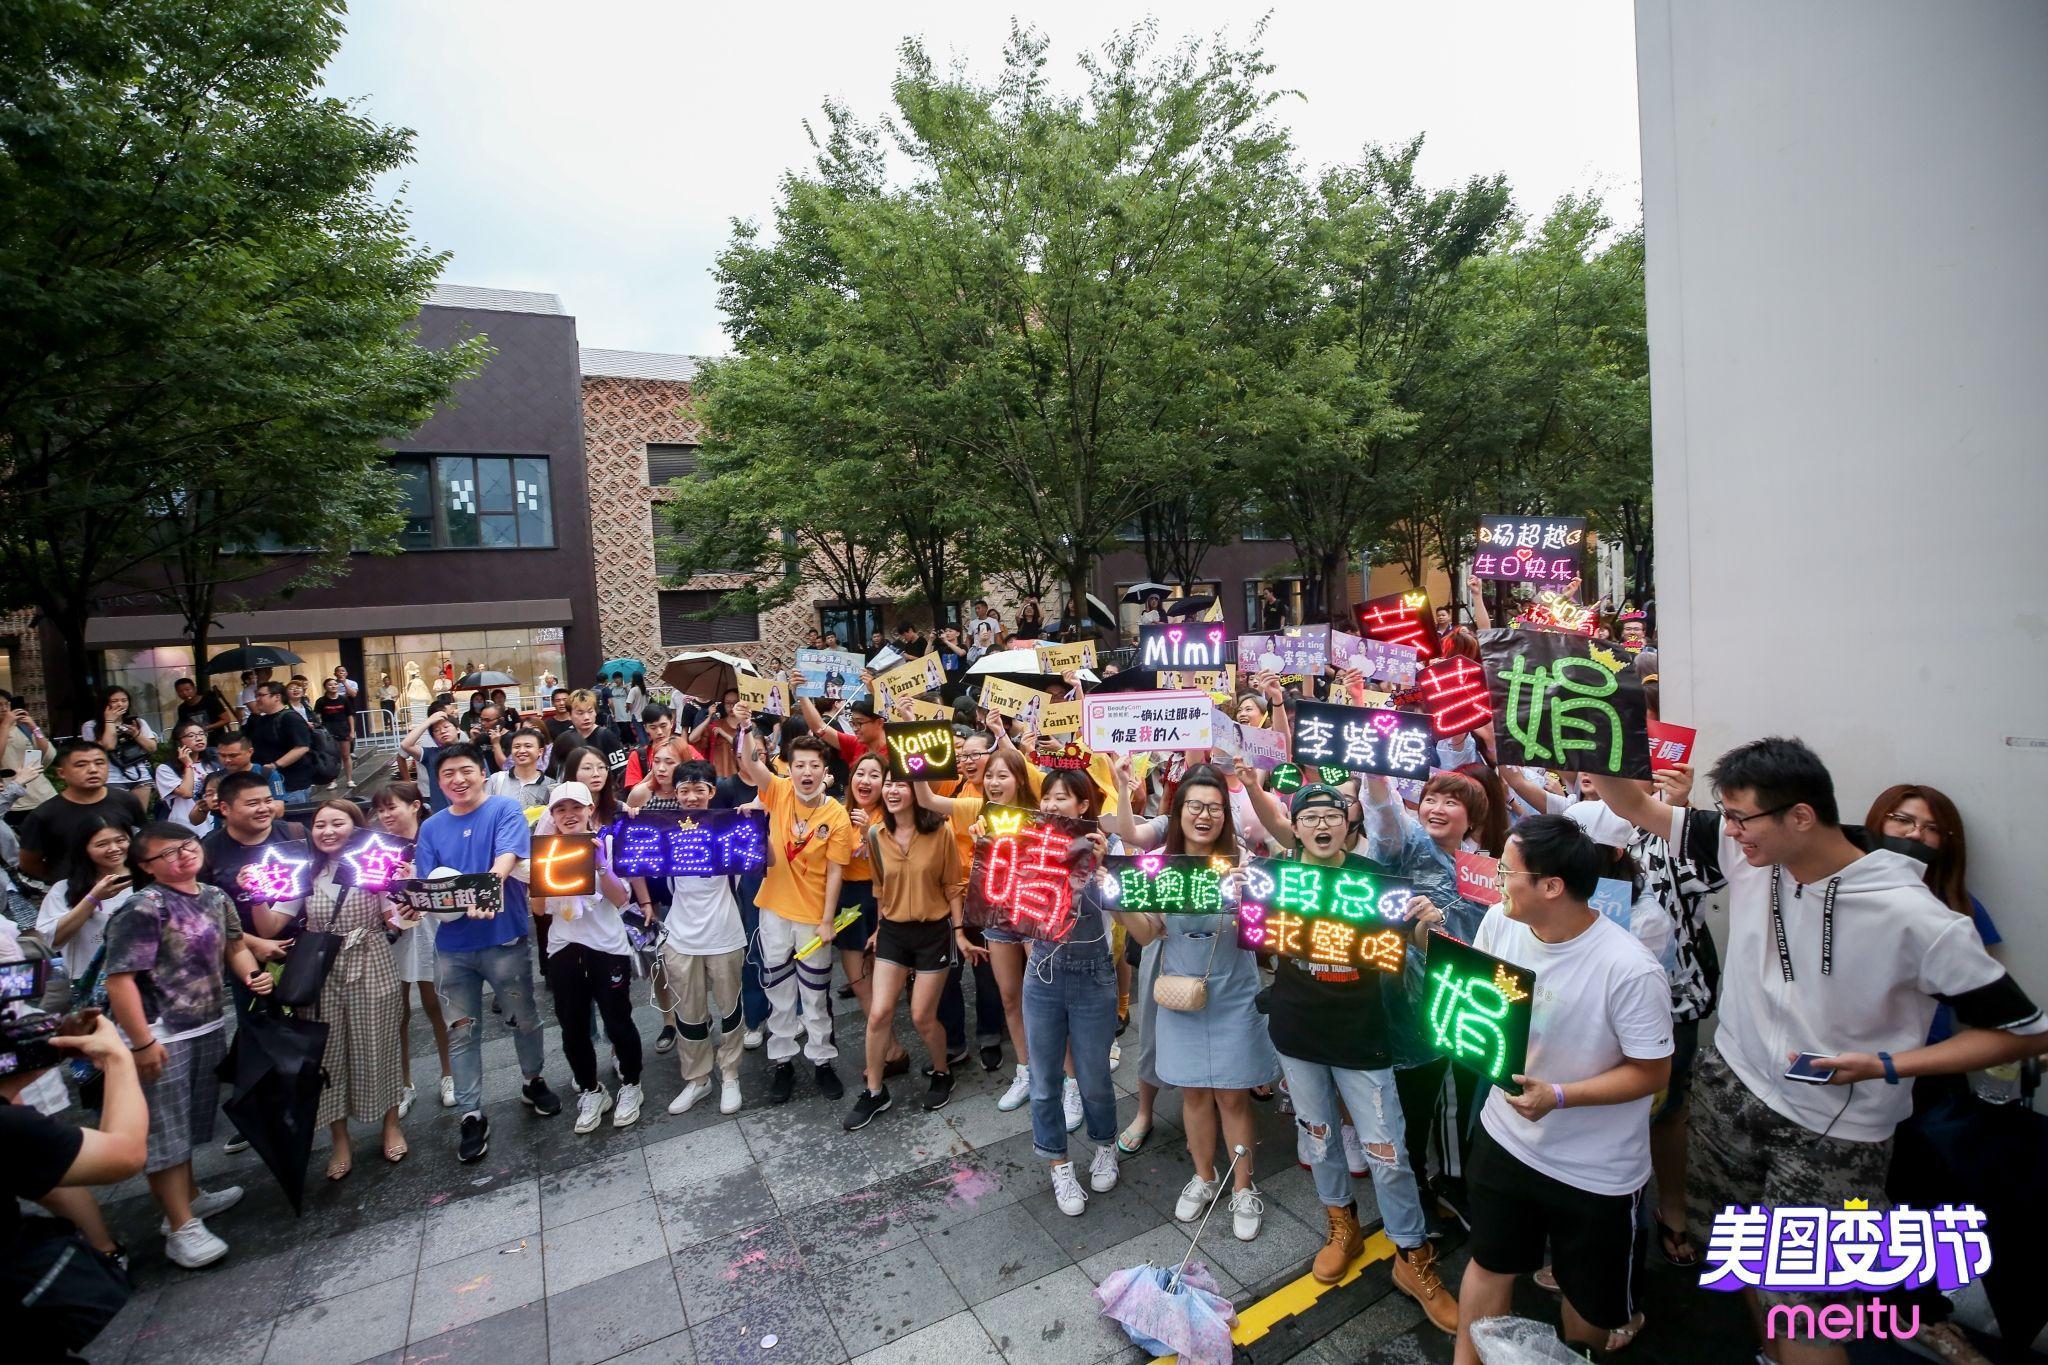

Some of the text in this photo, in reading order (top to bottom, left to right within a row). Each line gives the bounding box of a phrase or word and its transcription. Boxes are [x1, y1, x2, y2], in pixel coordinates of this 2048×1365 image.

[1491, 522, 1568, 550] 杨超越
[1474, 553, 1572, 581] 生日快乐
[1050, 654, 1081, 667] YamY!
[1144, 630, 1223, 667] Mimi
[890, 673, 926, 696] YamY!
[989, 690, 1022, 711] YamY!
[1107, 704, 1141, 712] BeautyCam
[1497, 655, 1622, 773] 娟
[608, 749, 626, 765] 05
[887, 728, 952, 774] Yamy
[1297, 715, 1428, 773] 李紫婷
[536, 837, 587, 892] 七
[618, 824, 763, 873] 吴宣仪
[410, 887, 478, 909] 杨超越
[985, 825, 1073, 933] 晴
[1120, 867, 1223, 910] 段奥娟
[1279, 867, 1376, 918] 段总
[1264, 911, 1402, 972] 求壁咚
[1430, 964, 1510, 1078] 娟
